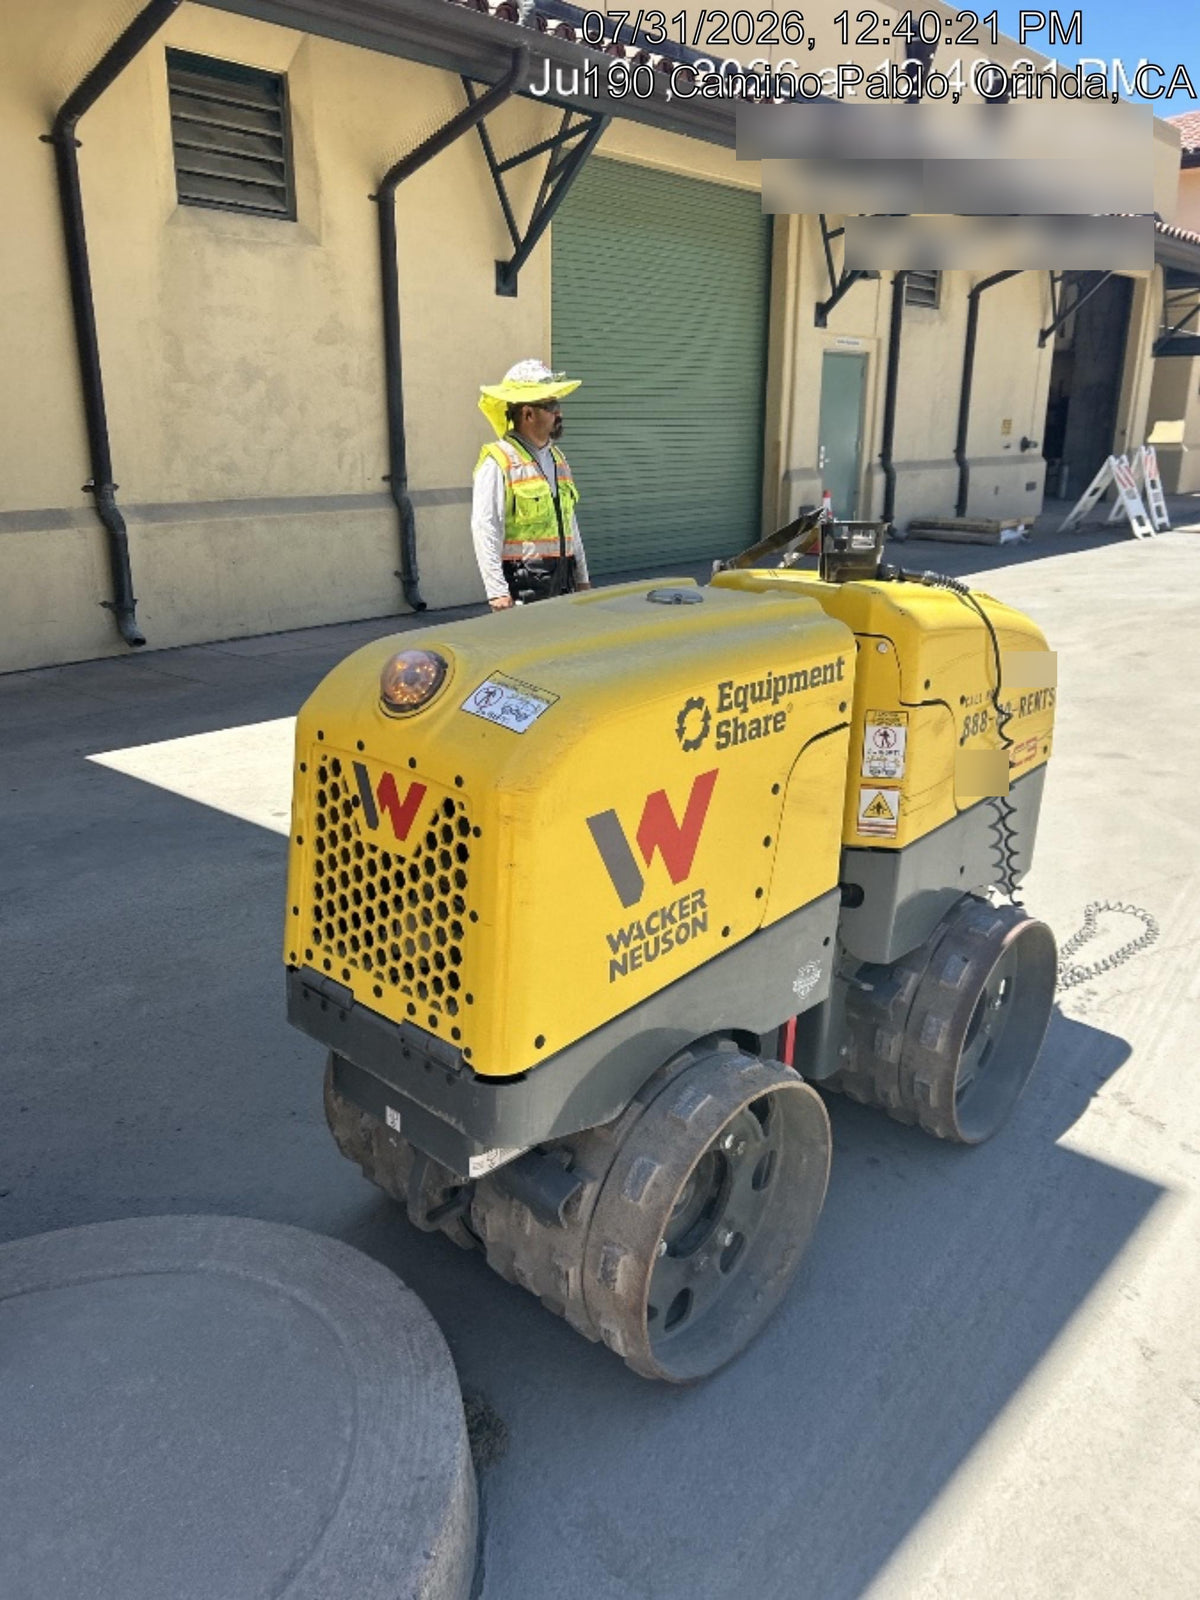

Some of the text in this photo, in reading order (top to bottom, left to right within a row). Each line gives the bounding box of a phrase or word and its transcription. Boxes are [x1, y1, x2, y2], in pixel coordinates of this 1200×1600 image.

[717, 656, 845, 713] Equipment
[715, 710, 787, 751] Share
[606, 888, 708, 955] WACKER
[609, 911, 708, 984] NEUSON
